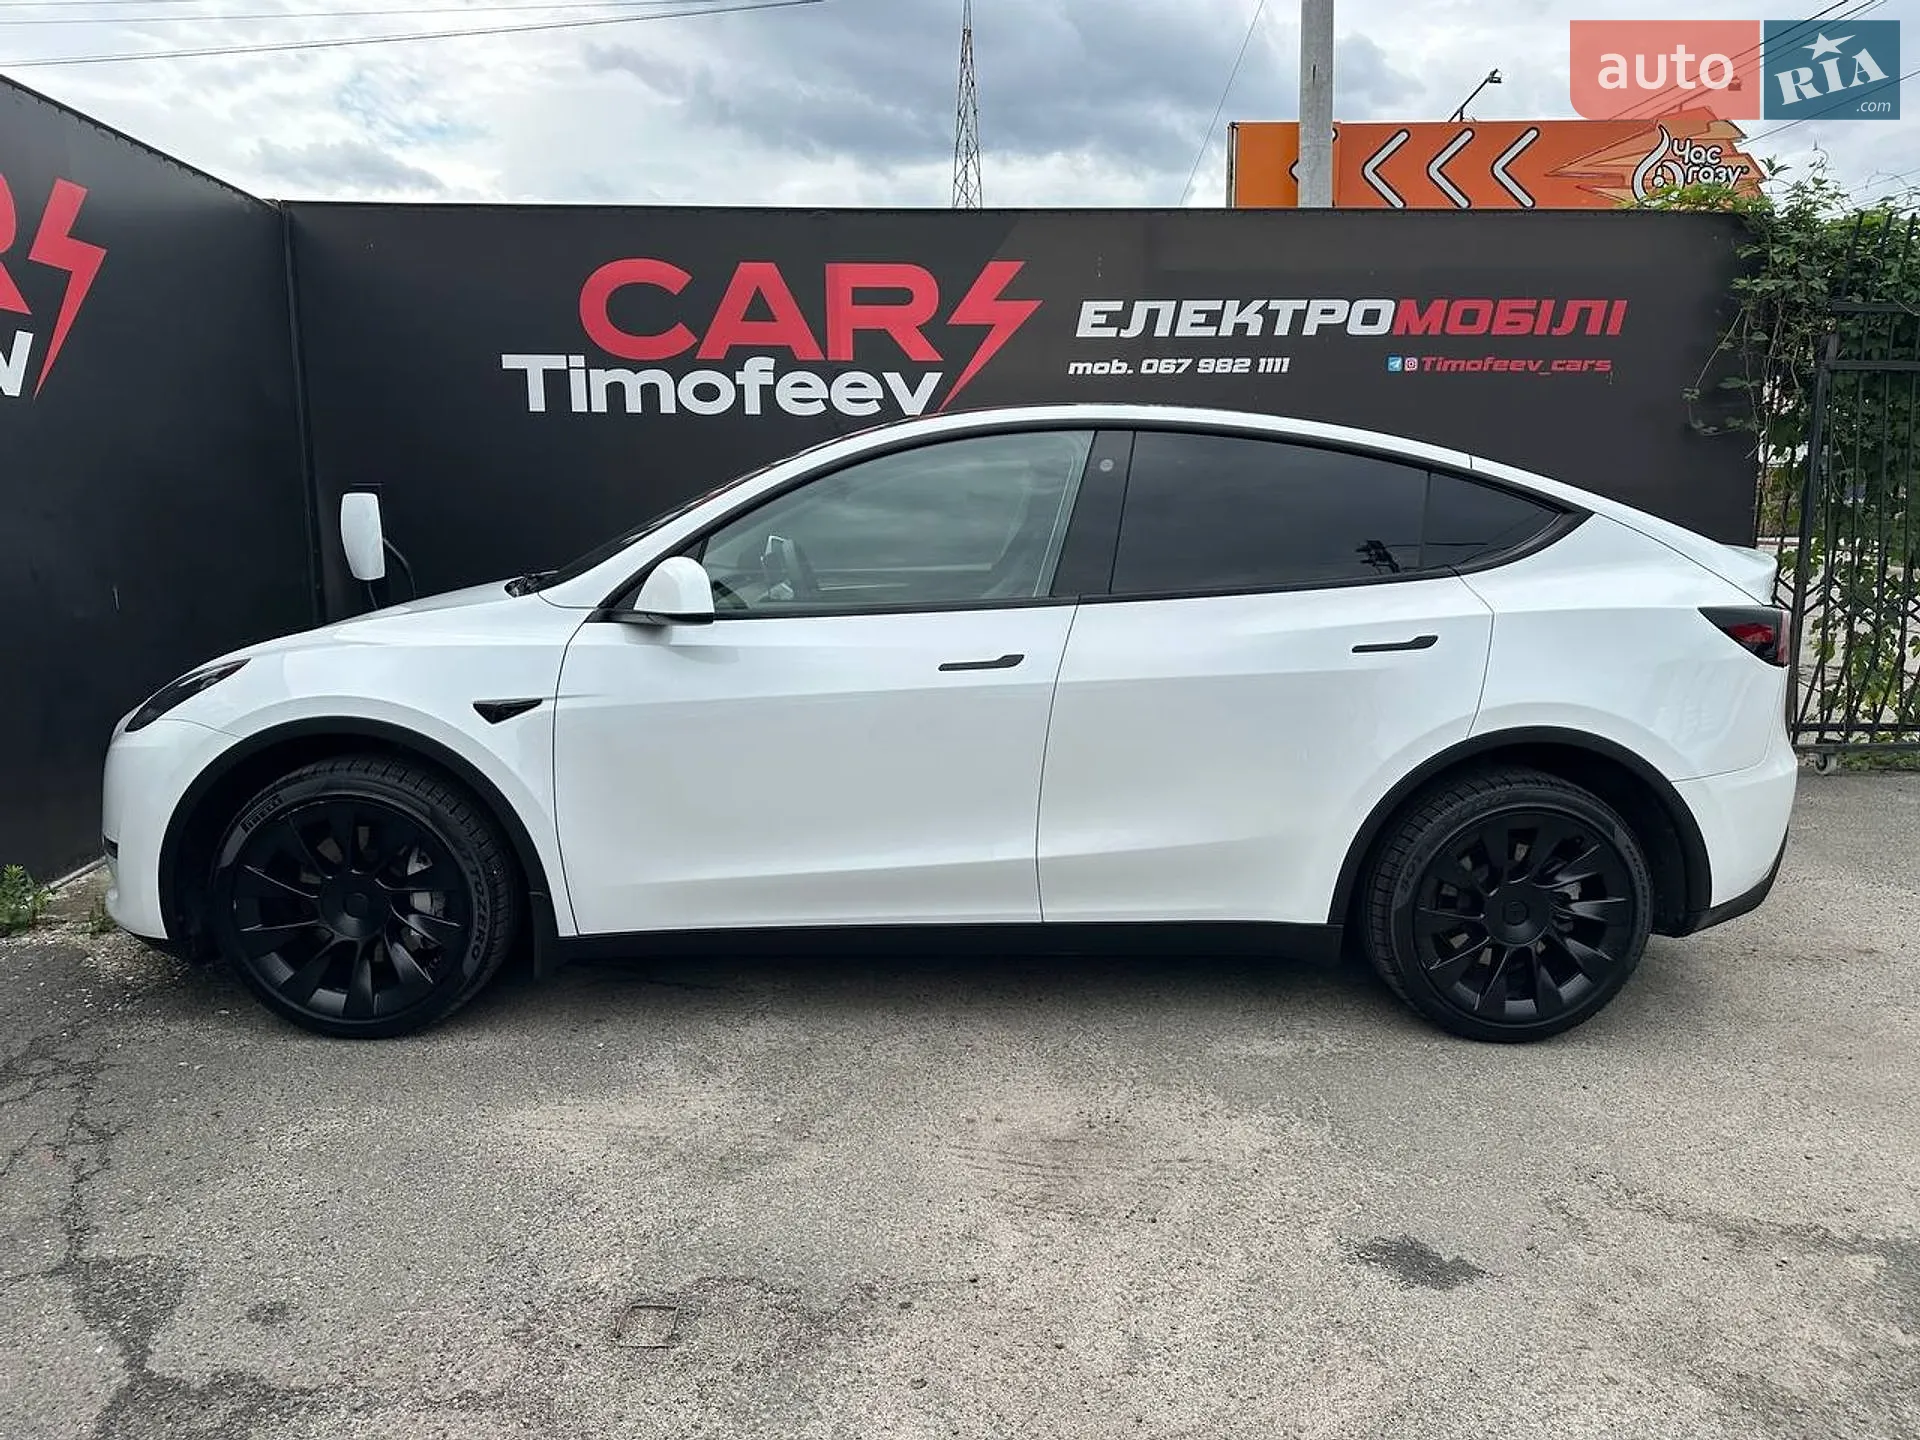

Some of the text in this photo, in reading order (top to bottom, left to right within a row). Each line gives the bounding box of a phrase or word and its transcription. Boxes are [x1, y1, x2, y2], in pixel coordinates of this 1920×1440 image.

[1673, 138, 1722, 165] Час
[1076, 298, 1627, 339] ЕЛЕКТРОМОБІЛІ
[1068, 357, 1291, 375] mob. 067 982 1111
[1421, 356, 1612, 375] Timofeev_cars
[502, 354, 944, 417] Timofeev
